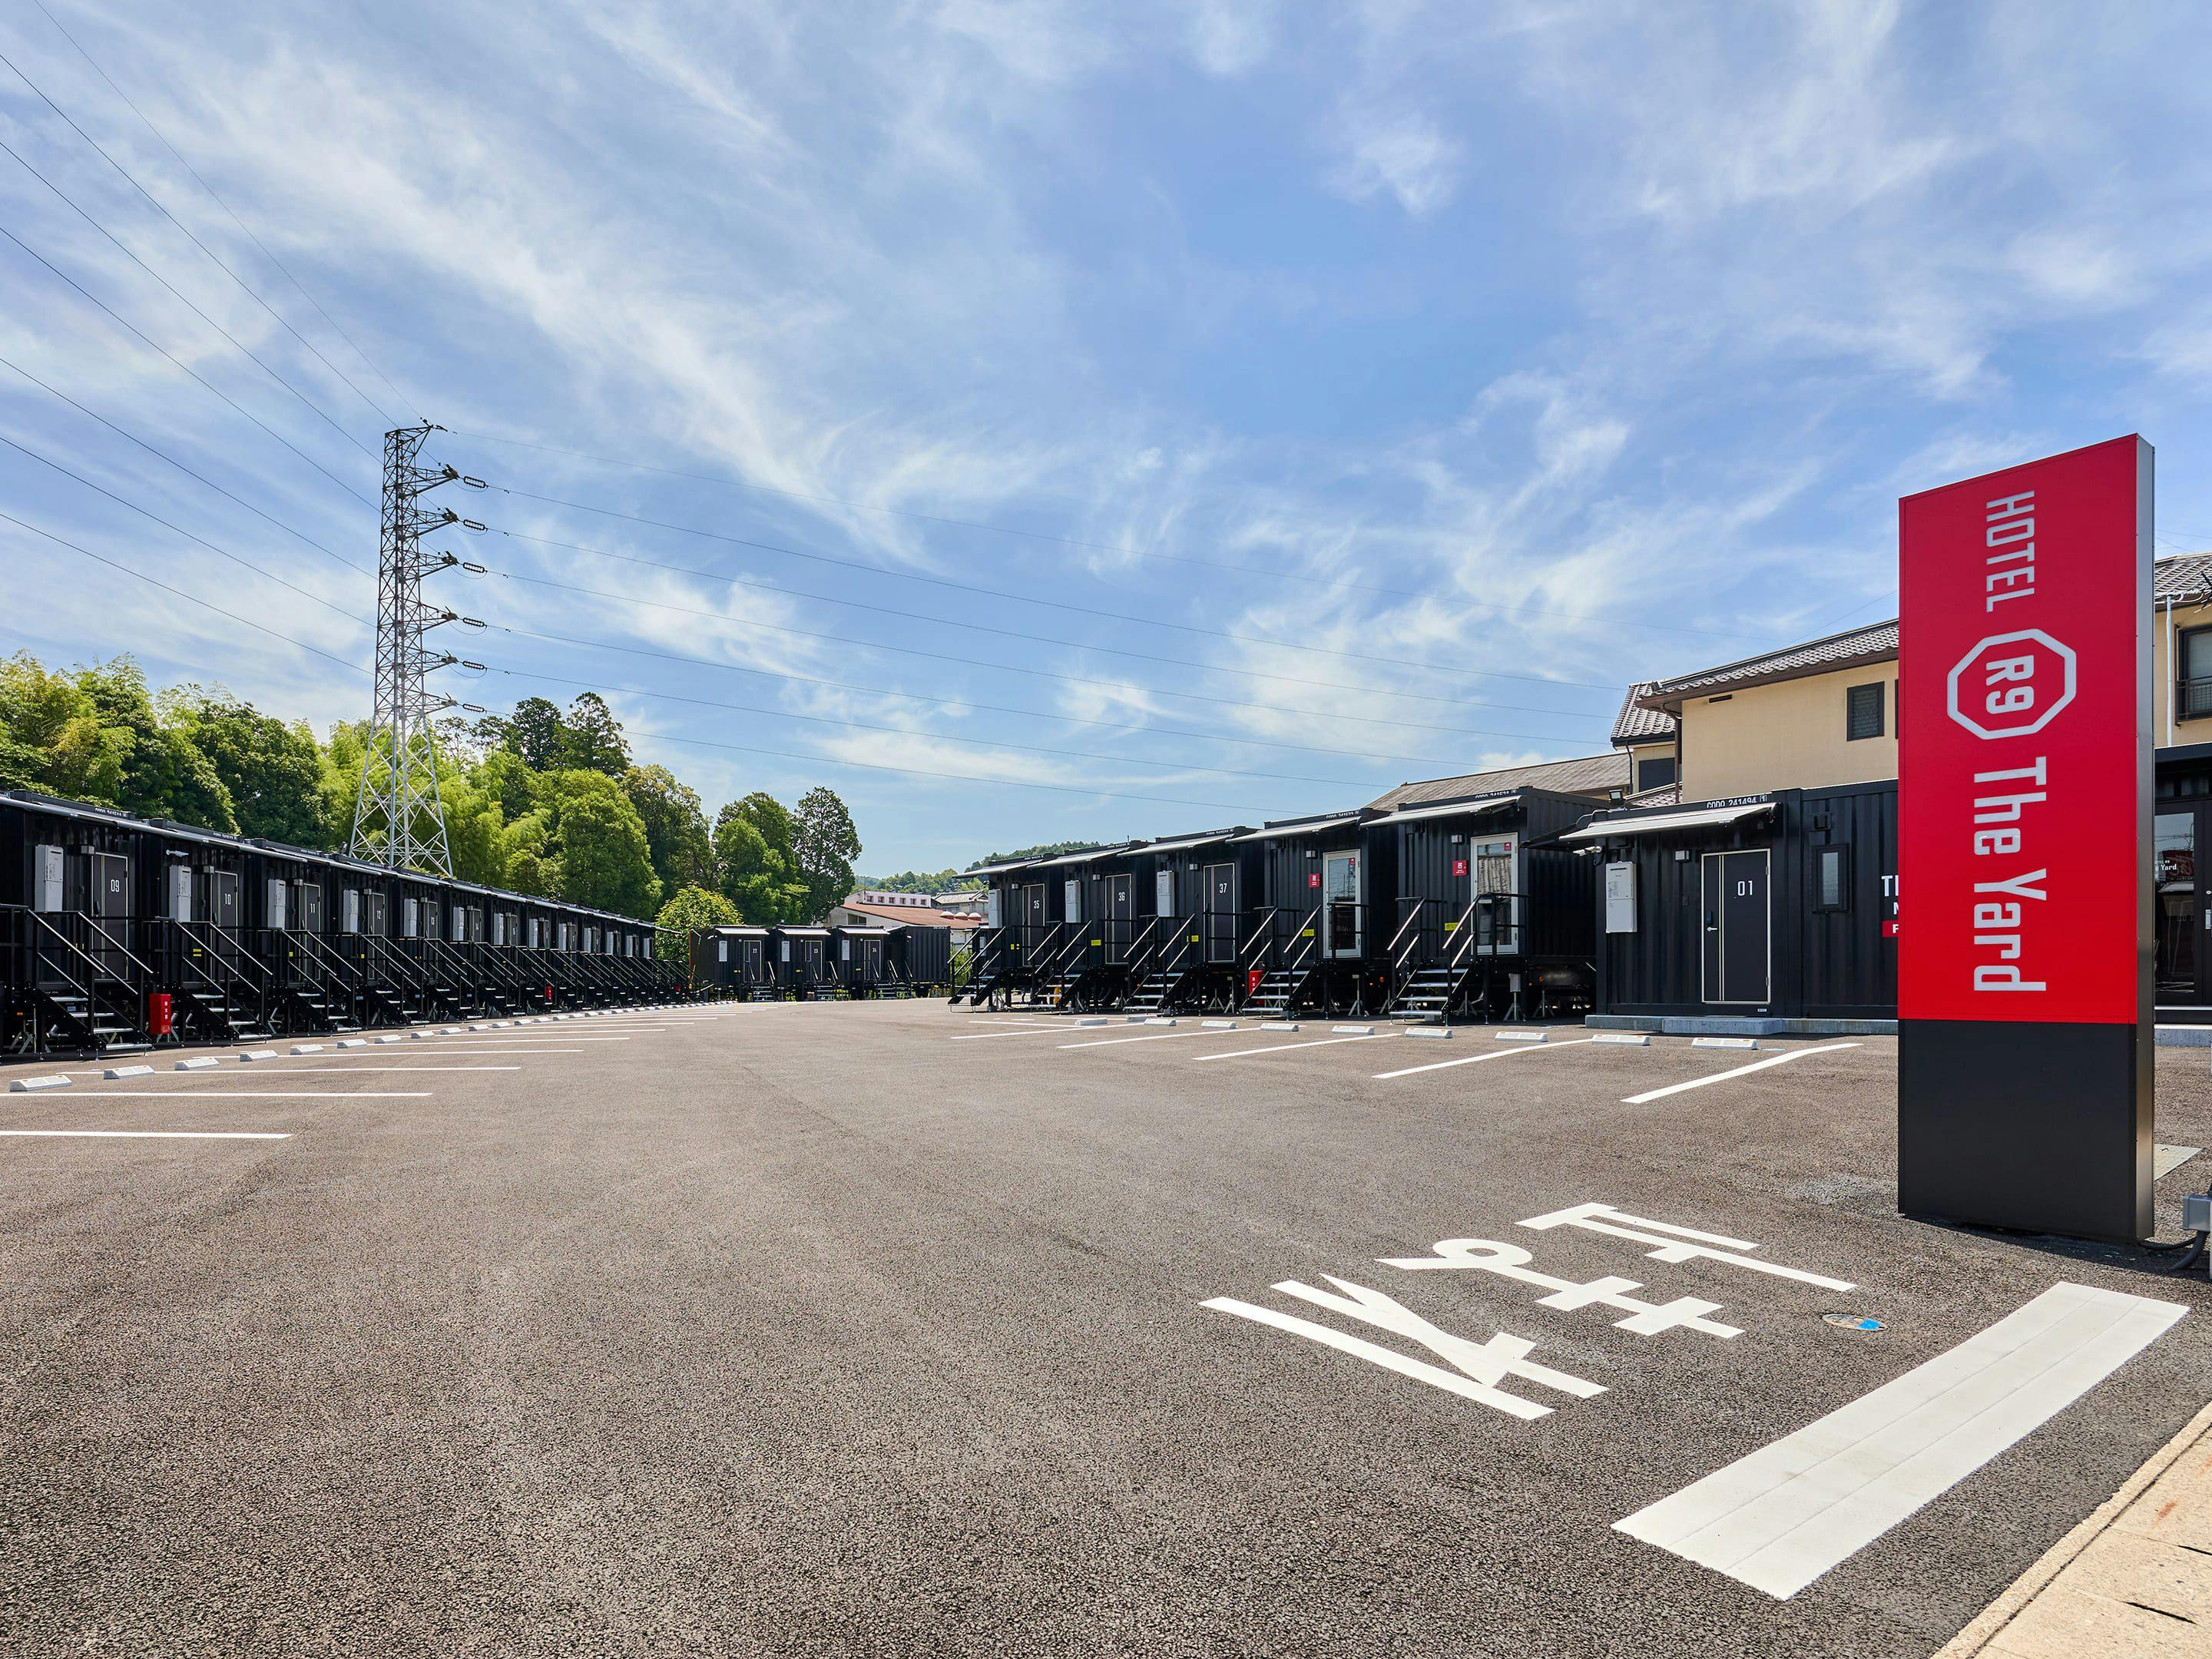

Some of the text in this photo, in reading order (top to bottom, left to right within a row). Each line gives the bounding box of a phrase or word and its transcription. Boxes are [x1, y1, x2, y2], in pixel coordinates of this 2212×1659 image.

[1974, 490, 2047, 992] HOTEL R9 The Yard
[111, 879, 120, 892] 09
[1219, 882, 1227, 893] 37
[1737, 880, 1753, 896] 01
[224, 893, 231, 905] 10
[1118, 891, 1125, 902] 36
[310, 902, 316, 914] 11
[1033, 899, 1040, 909] 35
[1197, 1202, 1859, 1420] 止まれ
